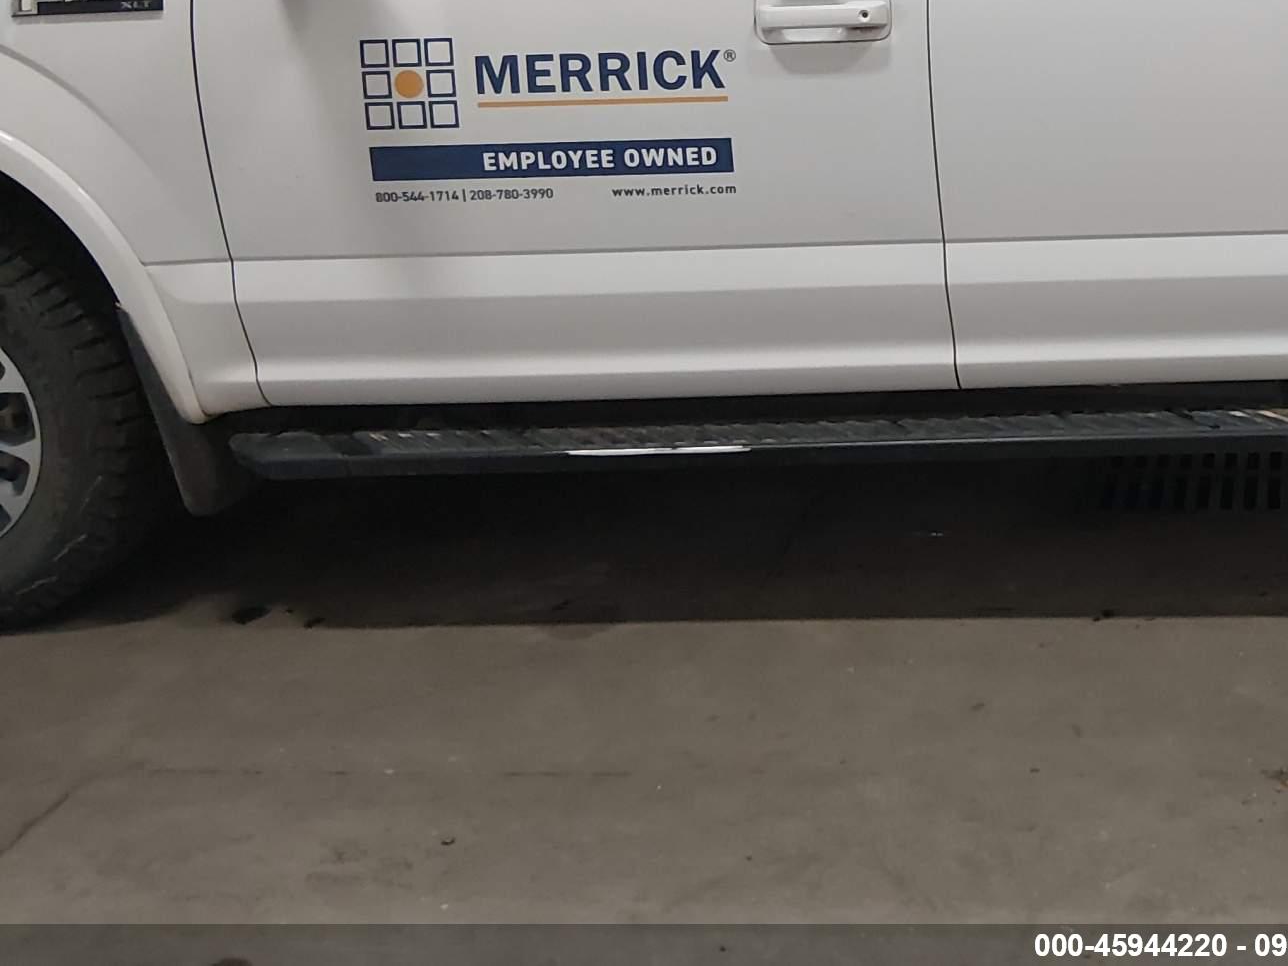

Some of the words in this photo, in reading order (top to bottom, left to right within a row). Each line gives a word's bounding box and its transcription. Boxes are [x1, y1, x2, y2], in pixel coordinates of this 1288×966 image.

[482, 149, 615, 171] EMPLOYEE
[623, 146, 717, 168] OWNED
[470, 188, 554, 201] 208-780-3990
[612, 184, 737, 197] www.merrick.com
